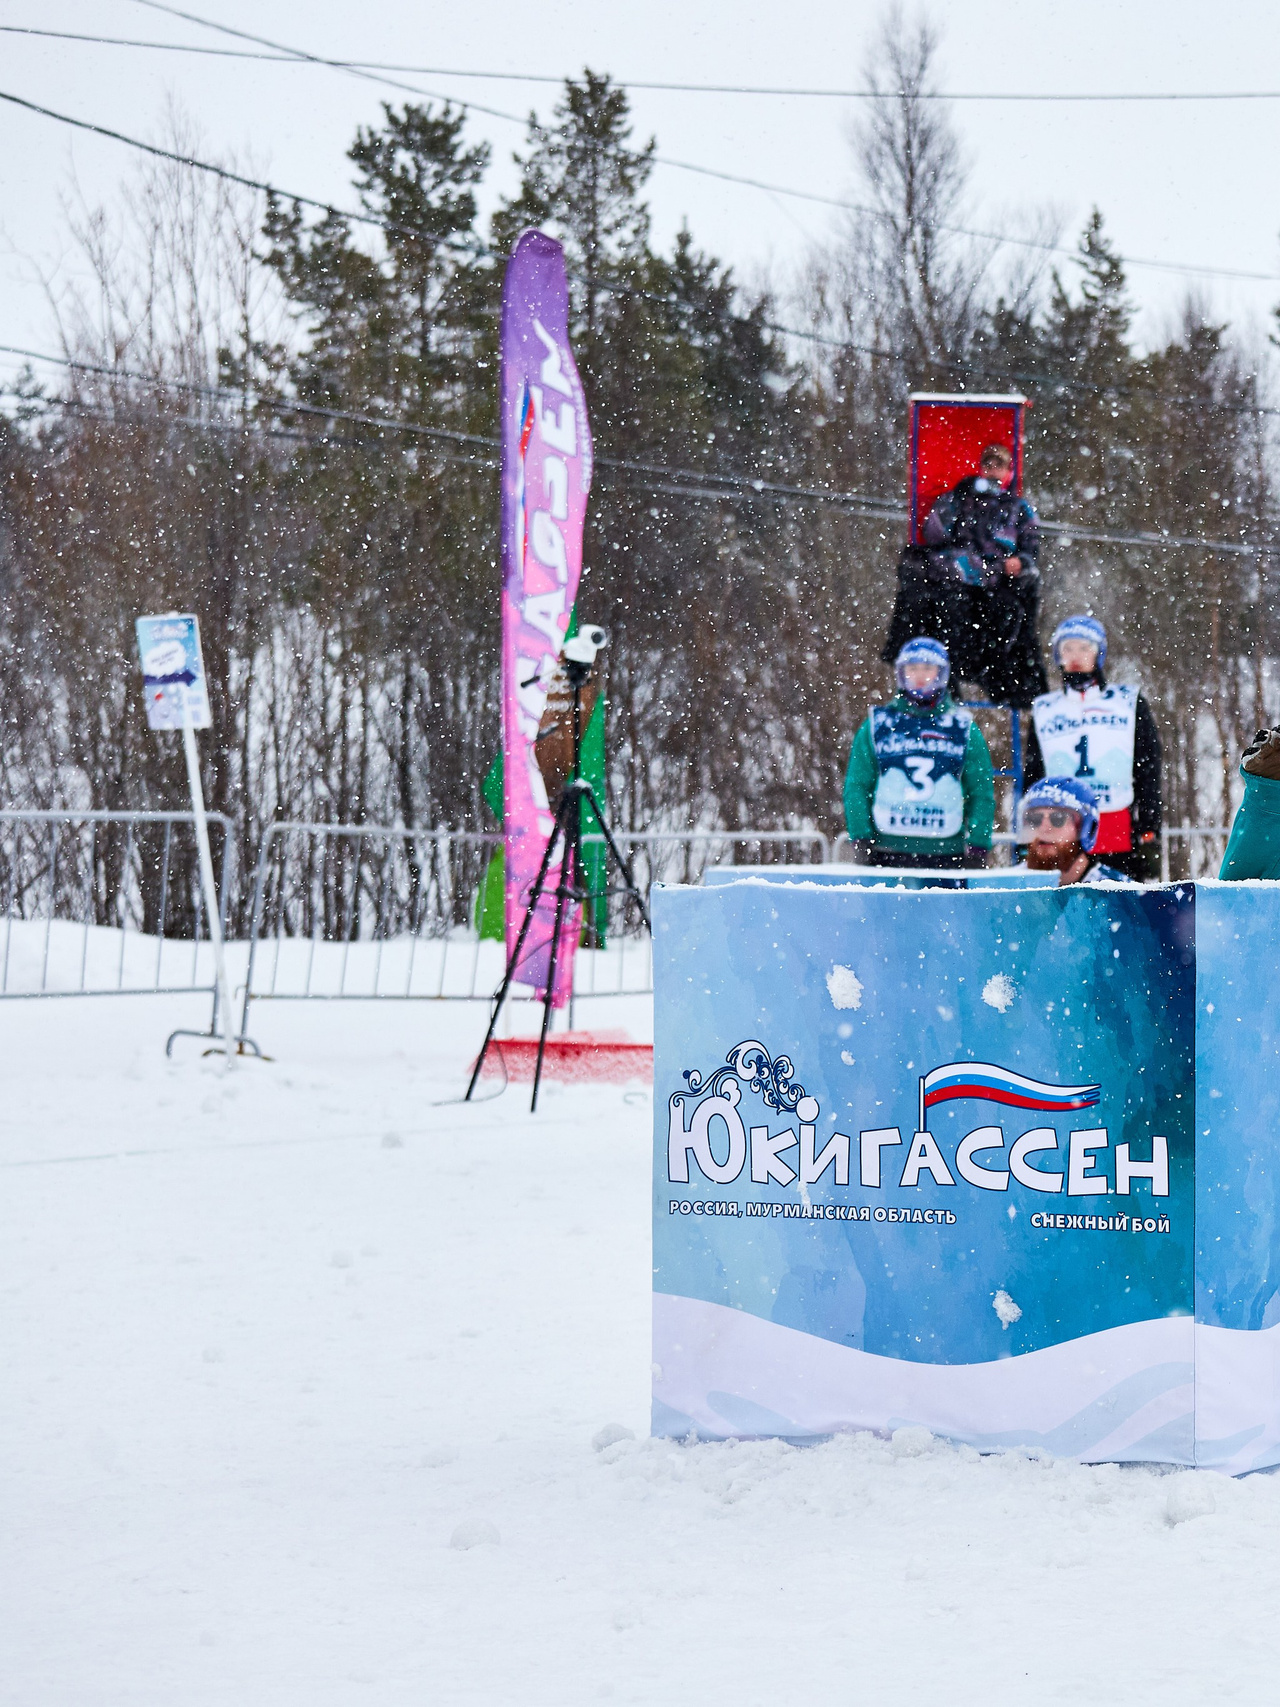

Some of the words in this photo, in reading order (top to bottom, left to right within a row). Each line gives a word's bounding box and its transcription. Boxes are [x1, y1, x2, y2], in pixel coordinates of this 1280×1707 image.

[1075, 735, 1095, 777] 1
[904, 756, 935, 801] 3
[669, 1200, 744, 1218] РОССИЯ,
[746, 1201, 870, 1221] МУРМАНСКАЯ
[873, 1207, 957, 1225] ОБЛАСТЬ
[1030, 1212, 1128, 1232] СНЕЖНЫЙ
[1131, 1214, 1171, 1233] БОЙ
